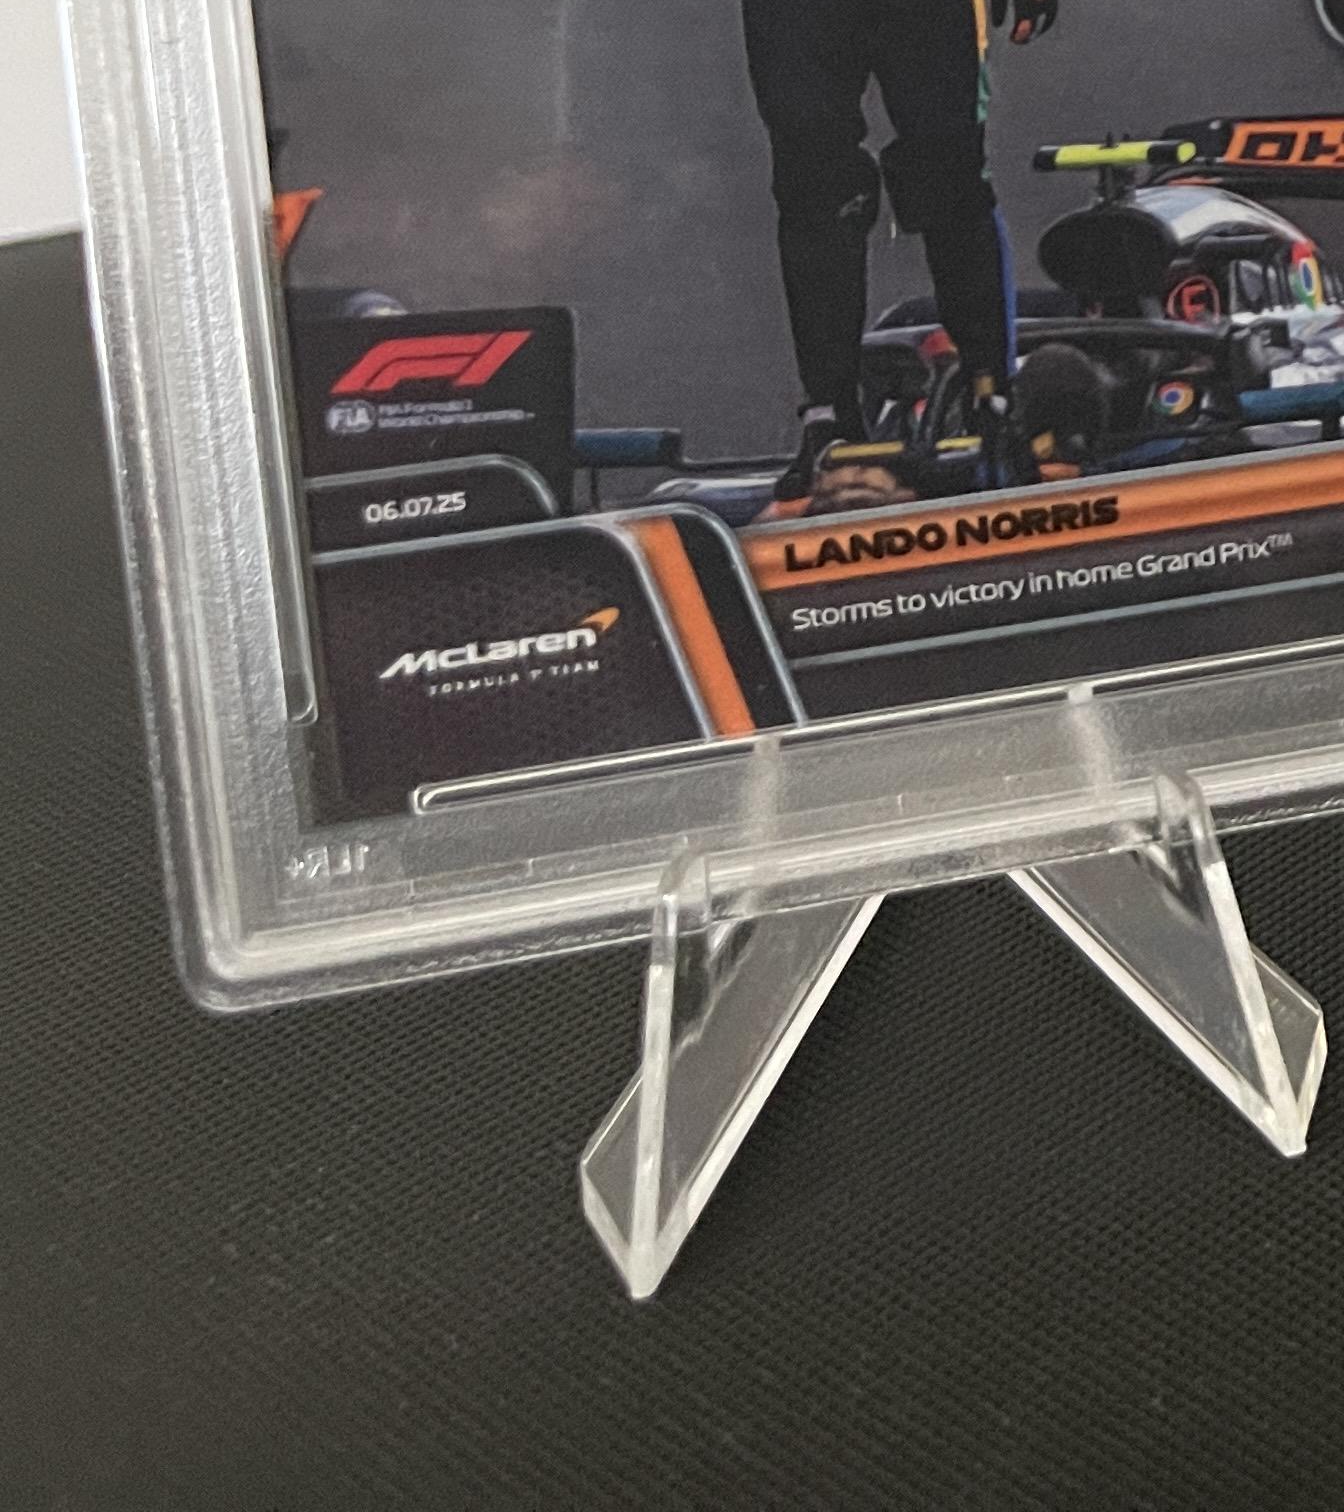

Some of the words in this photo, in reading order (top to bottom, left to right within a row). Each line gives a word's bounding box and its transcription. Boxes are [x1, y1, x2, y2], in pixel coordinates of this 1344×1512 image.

[328, 329, 534, 396] F1
[364, 491, 468, 525] 06.07.25
[783, 521, 946, 574] LANDO
[955, 495, 1121, 548] NORRIS
[791, 599, 893, 632] Storms
[896, 592, 927, 614] to
[929, 570, 1025, 611] victory
[1028, 571, 1053, 594] in
[1057, 561, 1134, 590] home
[1136, 545, 1216, 579] Grand
[378, 627, 598, 680] McLaren
